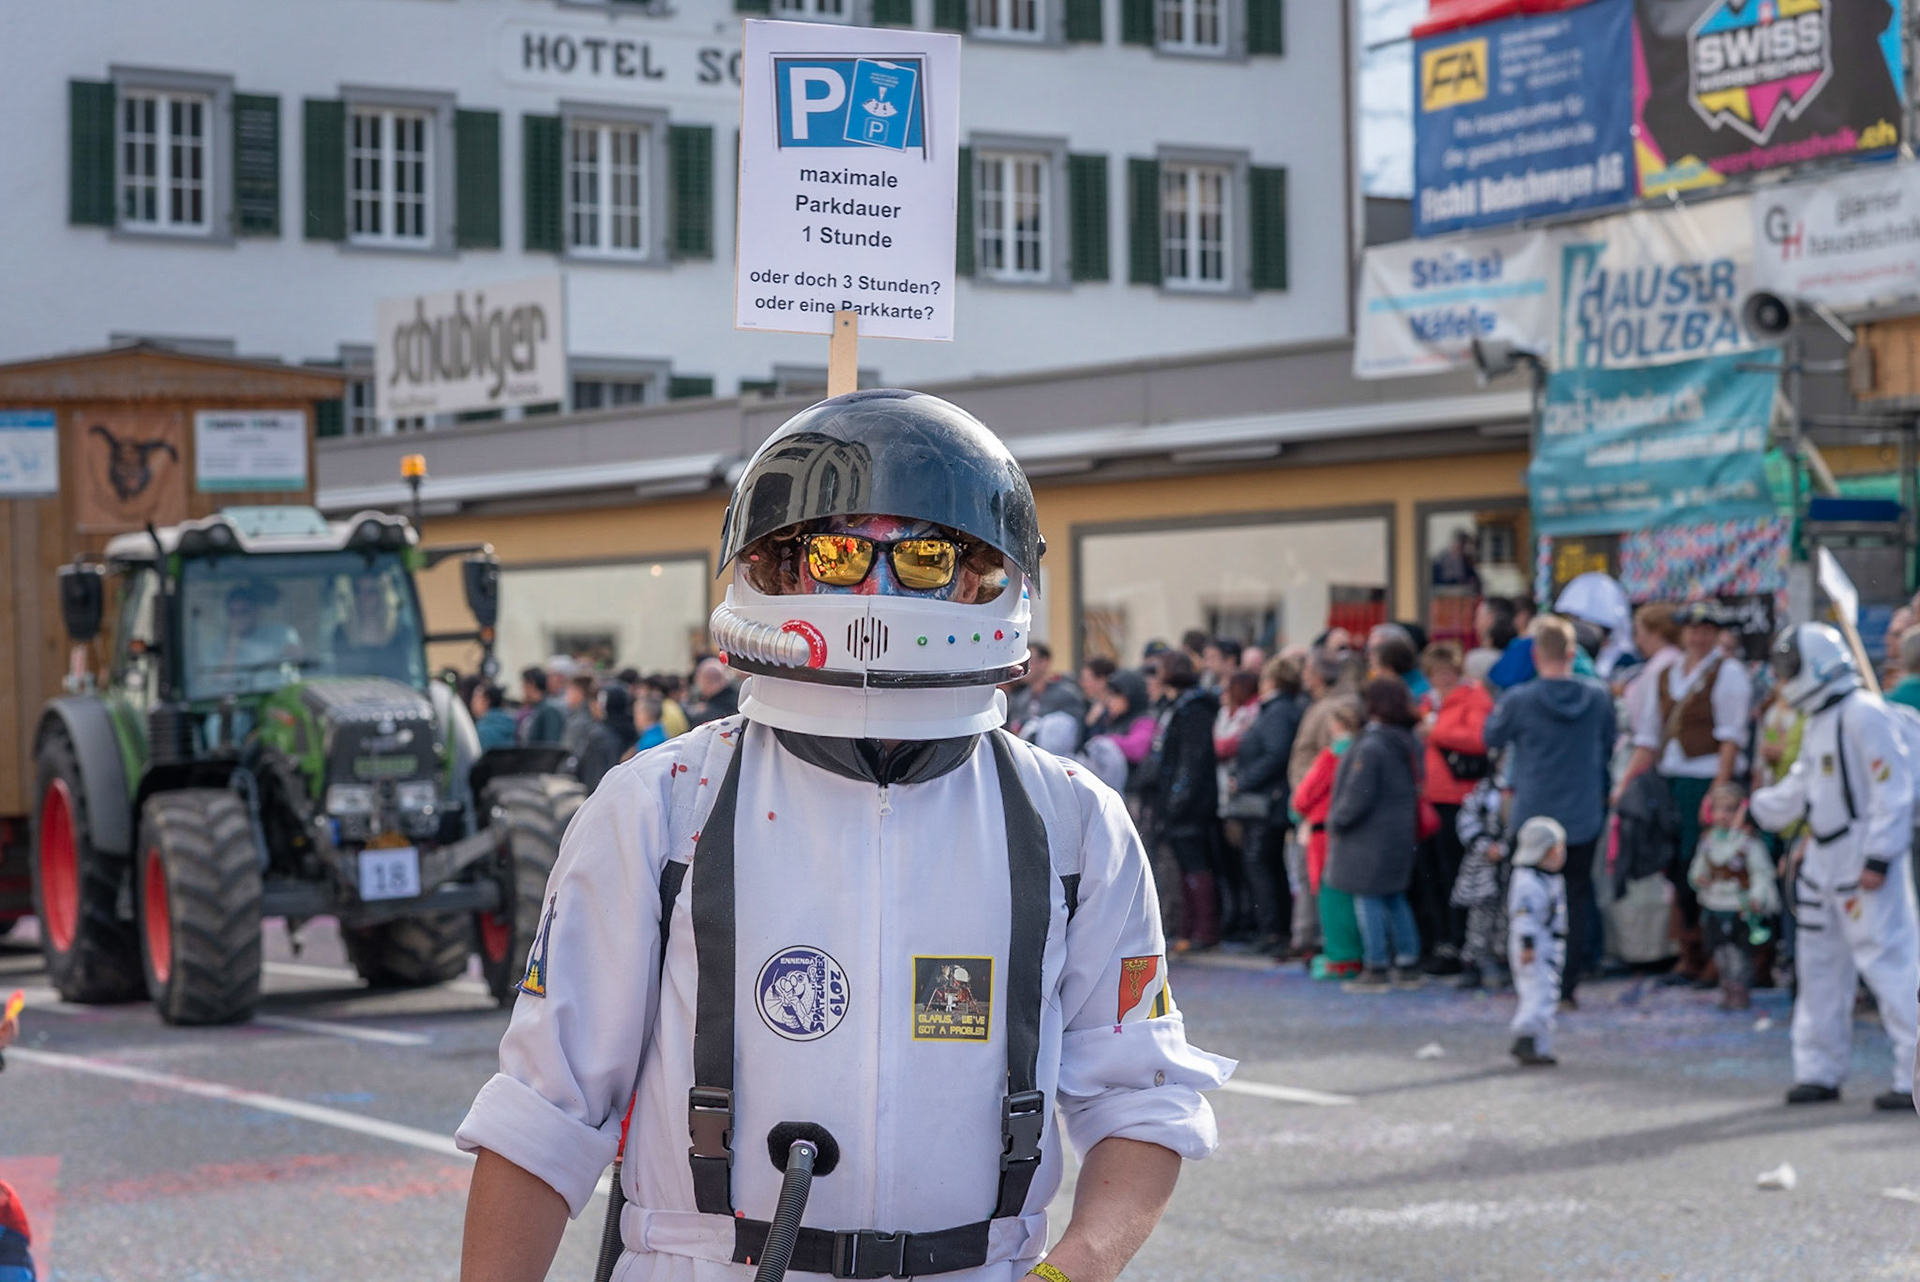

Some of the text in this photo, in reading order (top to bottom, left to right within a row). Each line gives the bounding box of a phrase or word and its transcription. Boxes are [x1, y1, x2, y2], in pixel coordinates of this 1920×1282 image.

[1697, 12, 1821, 74] SWISS
[523, 34, 665, 79] HOTEL
[789, 67, 846, 140] P
[869, 121, 884, 139] P
[800, 168, 898, 188] maximale
[795, 194, 902, 218] Parkdauer
[802, 225, 893, 248] 1 Stunde
[750, 269, 941, 295] oder doch 3 Stunden?
[755, 295, 934, 320] oder eine Parkkarte?
[1582, 307, 1755, 365] HOLZBA
[373, 861, 408, 889] 18
[830, 970, 846, 1017] 2019
[918, 1025, 935, 1035] GOT
[939, 1026, 946, 1034] A
[961, 1014, 985, 1025] WE'VE
